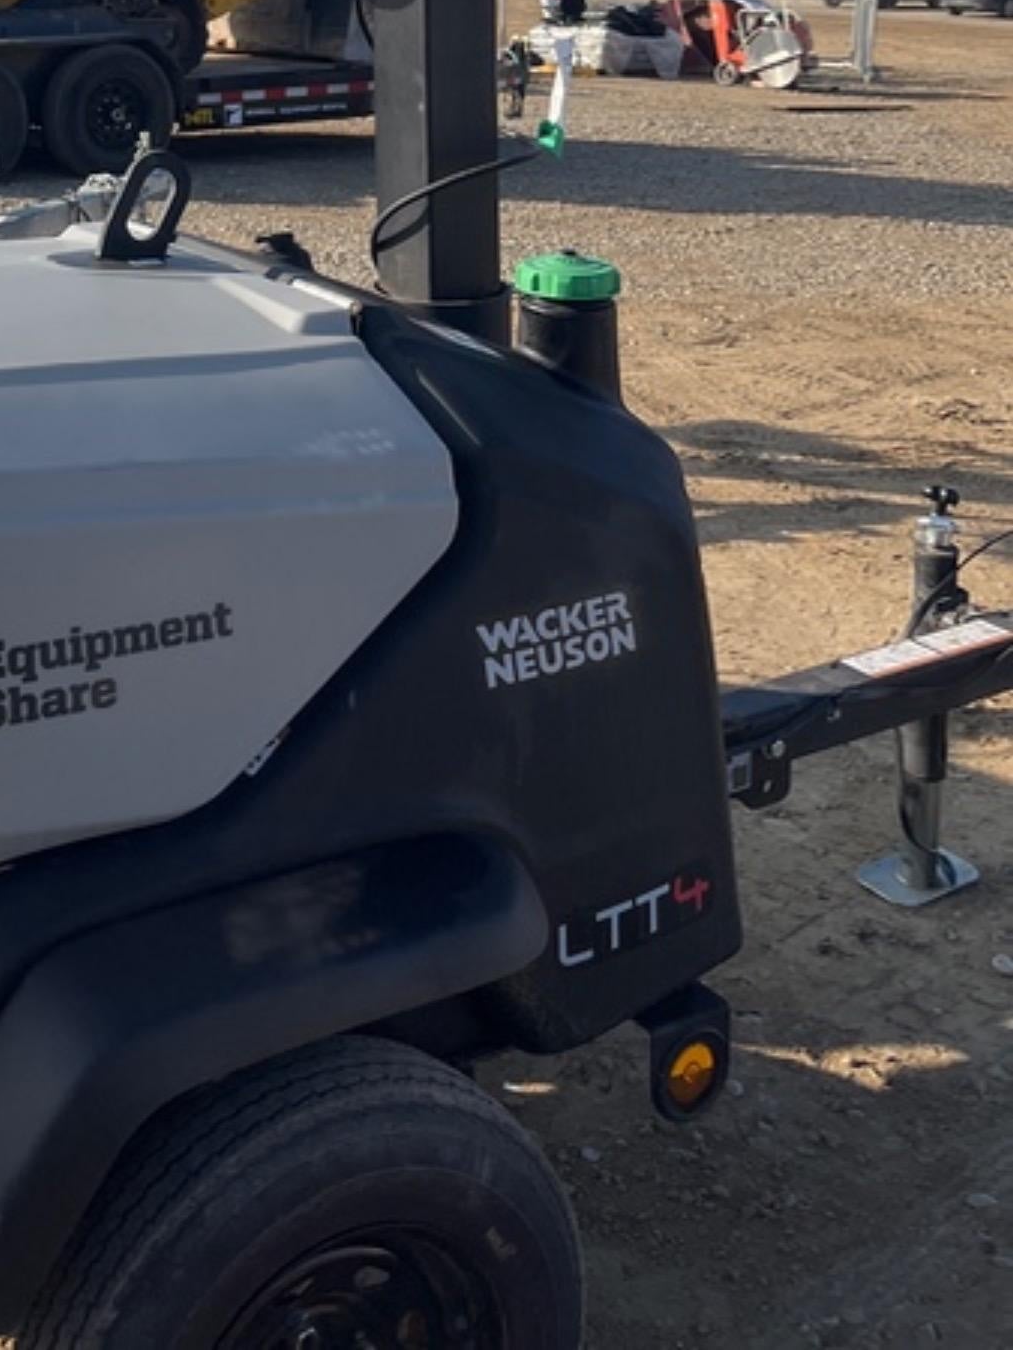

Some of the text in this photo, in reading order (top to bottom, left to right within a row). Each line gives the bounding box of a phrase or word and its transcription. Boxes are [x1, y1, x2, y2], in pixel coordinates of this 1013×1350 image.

[475, 591, 633, 654] WACKER
[483, 621, 637, 689] NEUSON
[558, 876, 710, 967] LTT4
